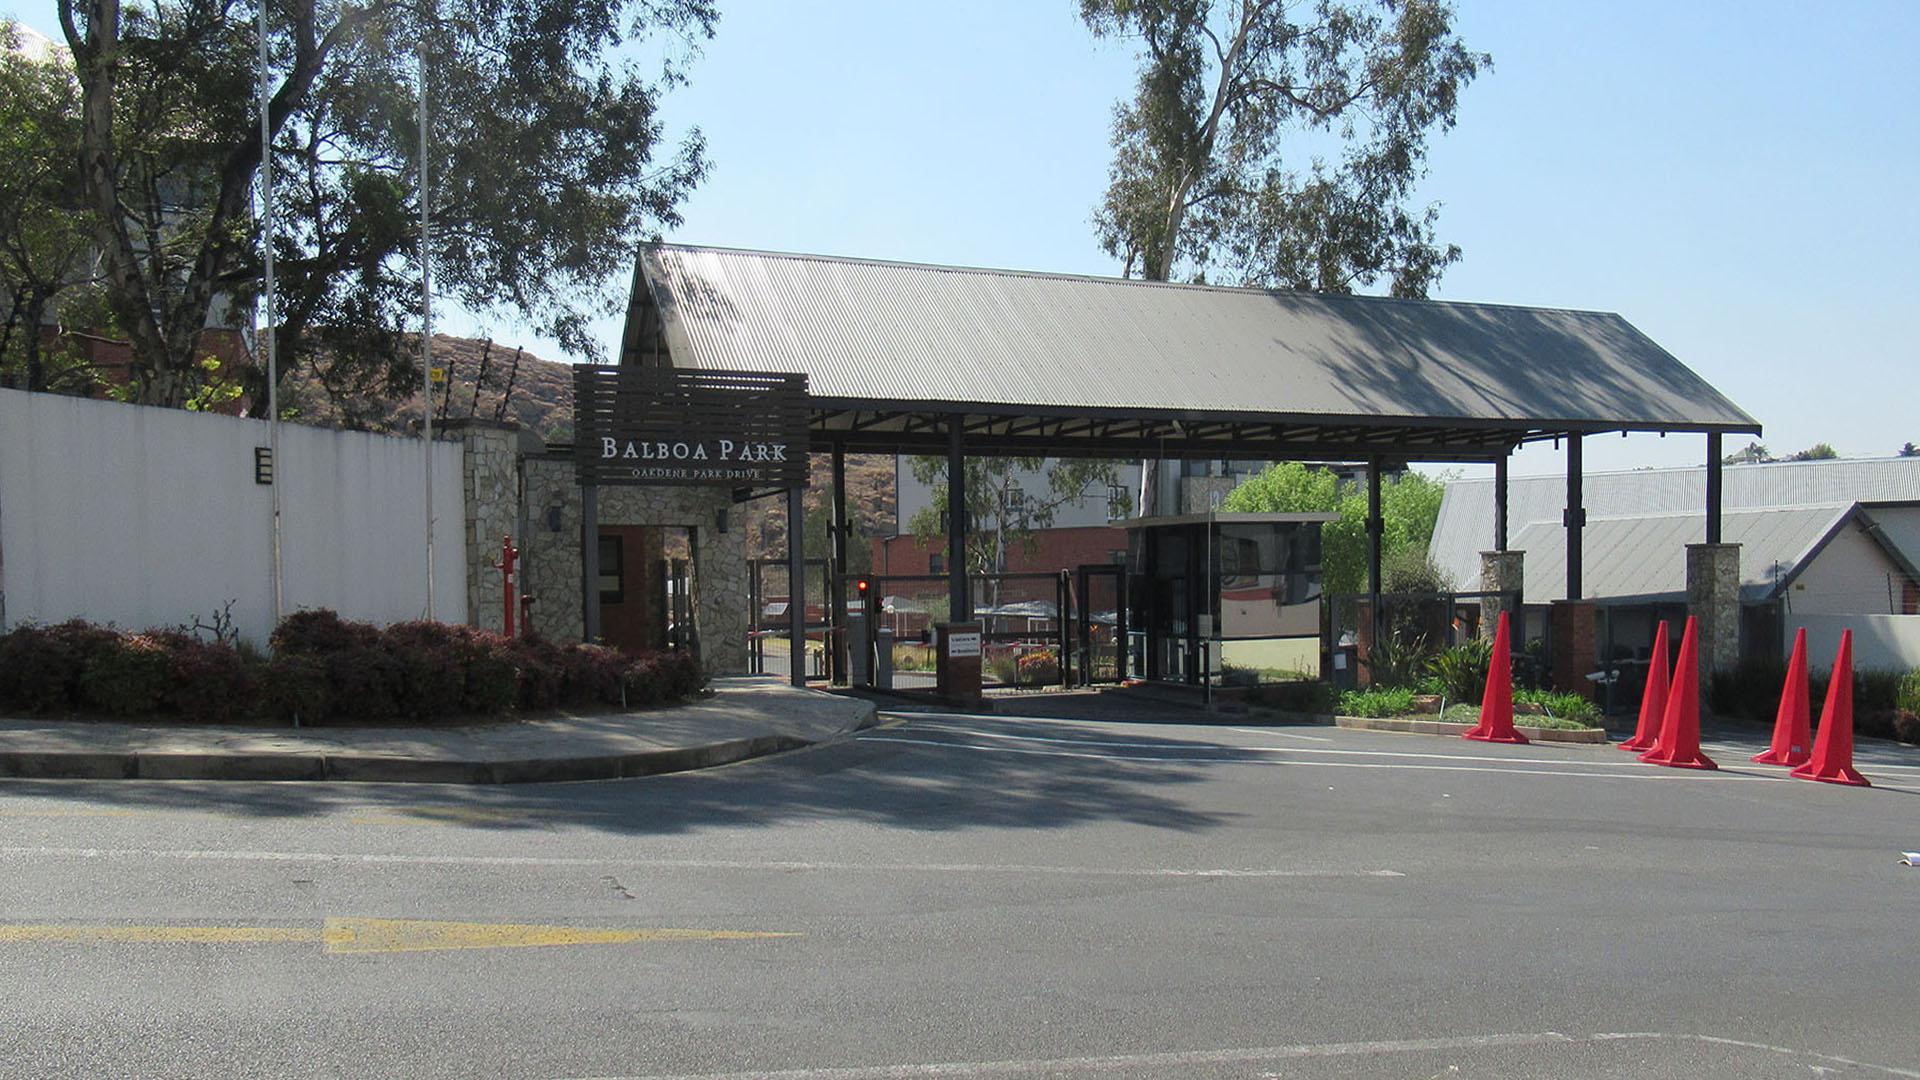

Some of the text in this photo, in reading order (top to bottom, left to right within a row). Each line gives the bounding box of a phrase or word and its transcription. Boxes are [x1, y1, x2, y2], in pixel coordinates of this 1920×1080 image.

[601, 437, 787, 461] BALBOA PARK
[693, 469, 722, 479] PARK
[726, 468, 761, 479] DRIVE
